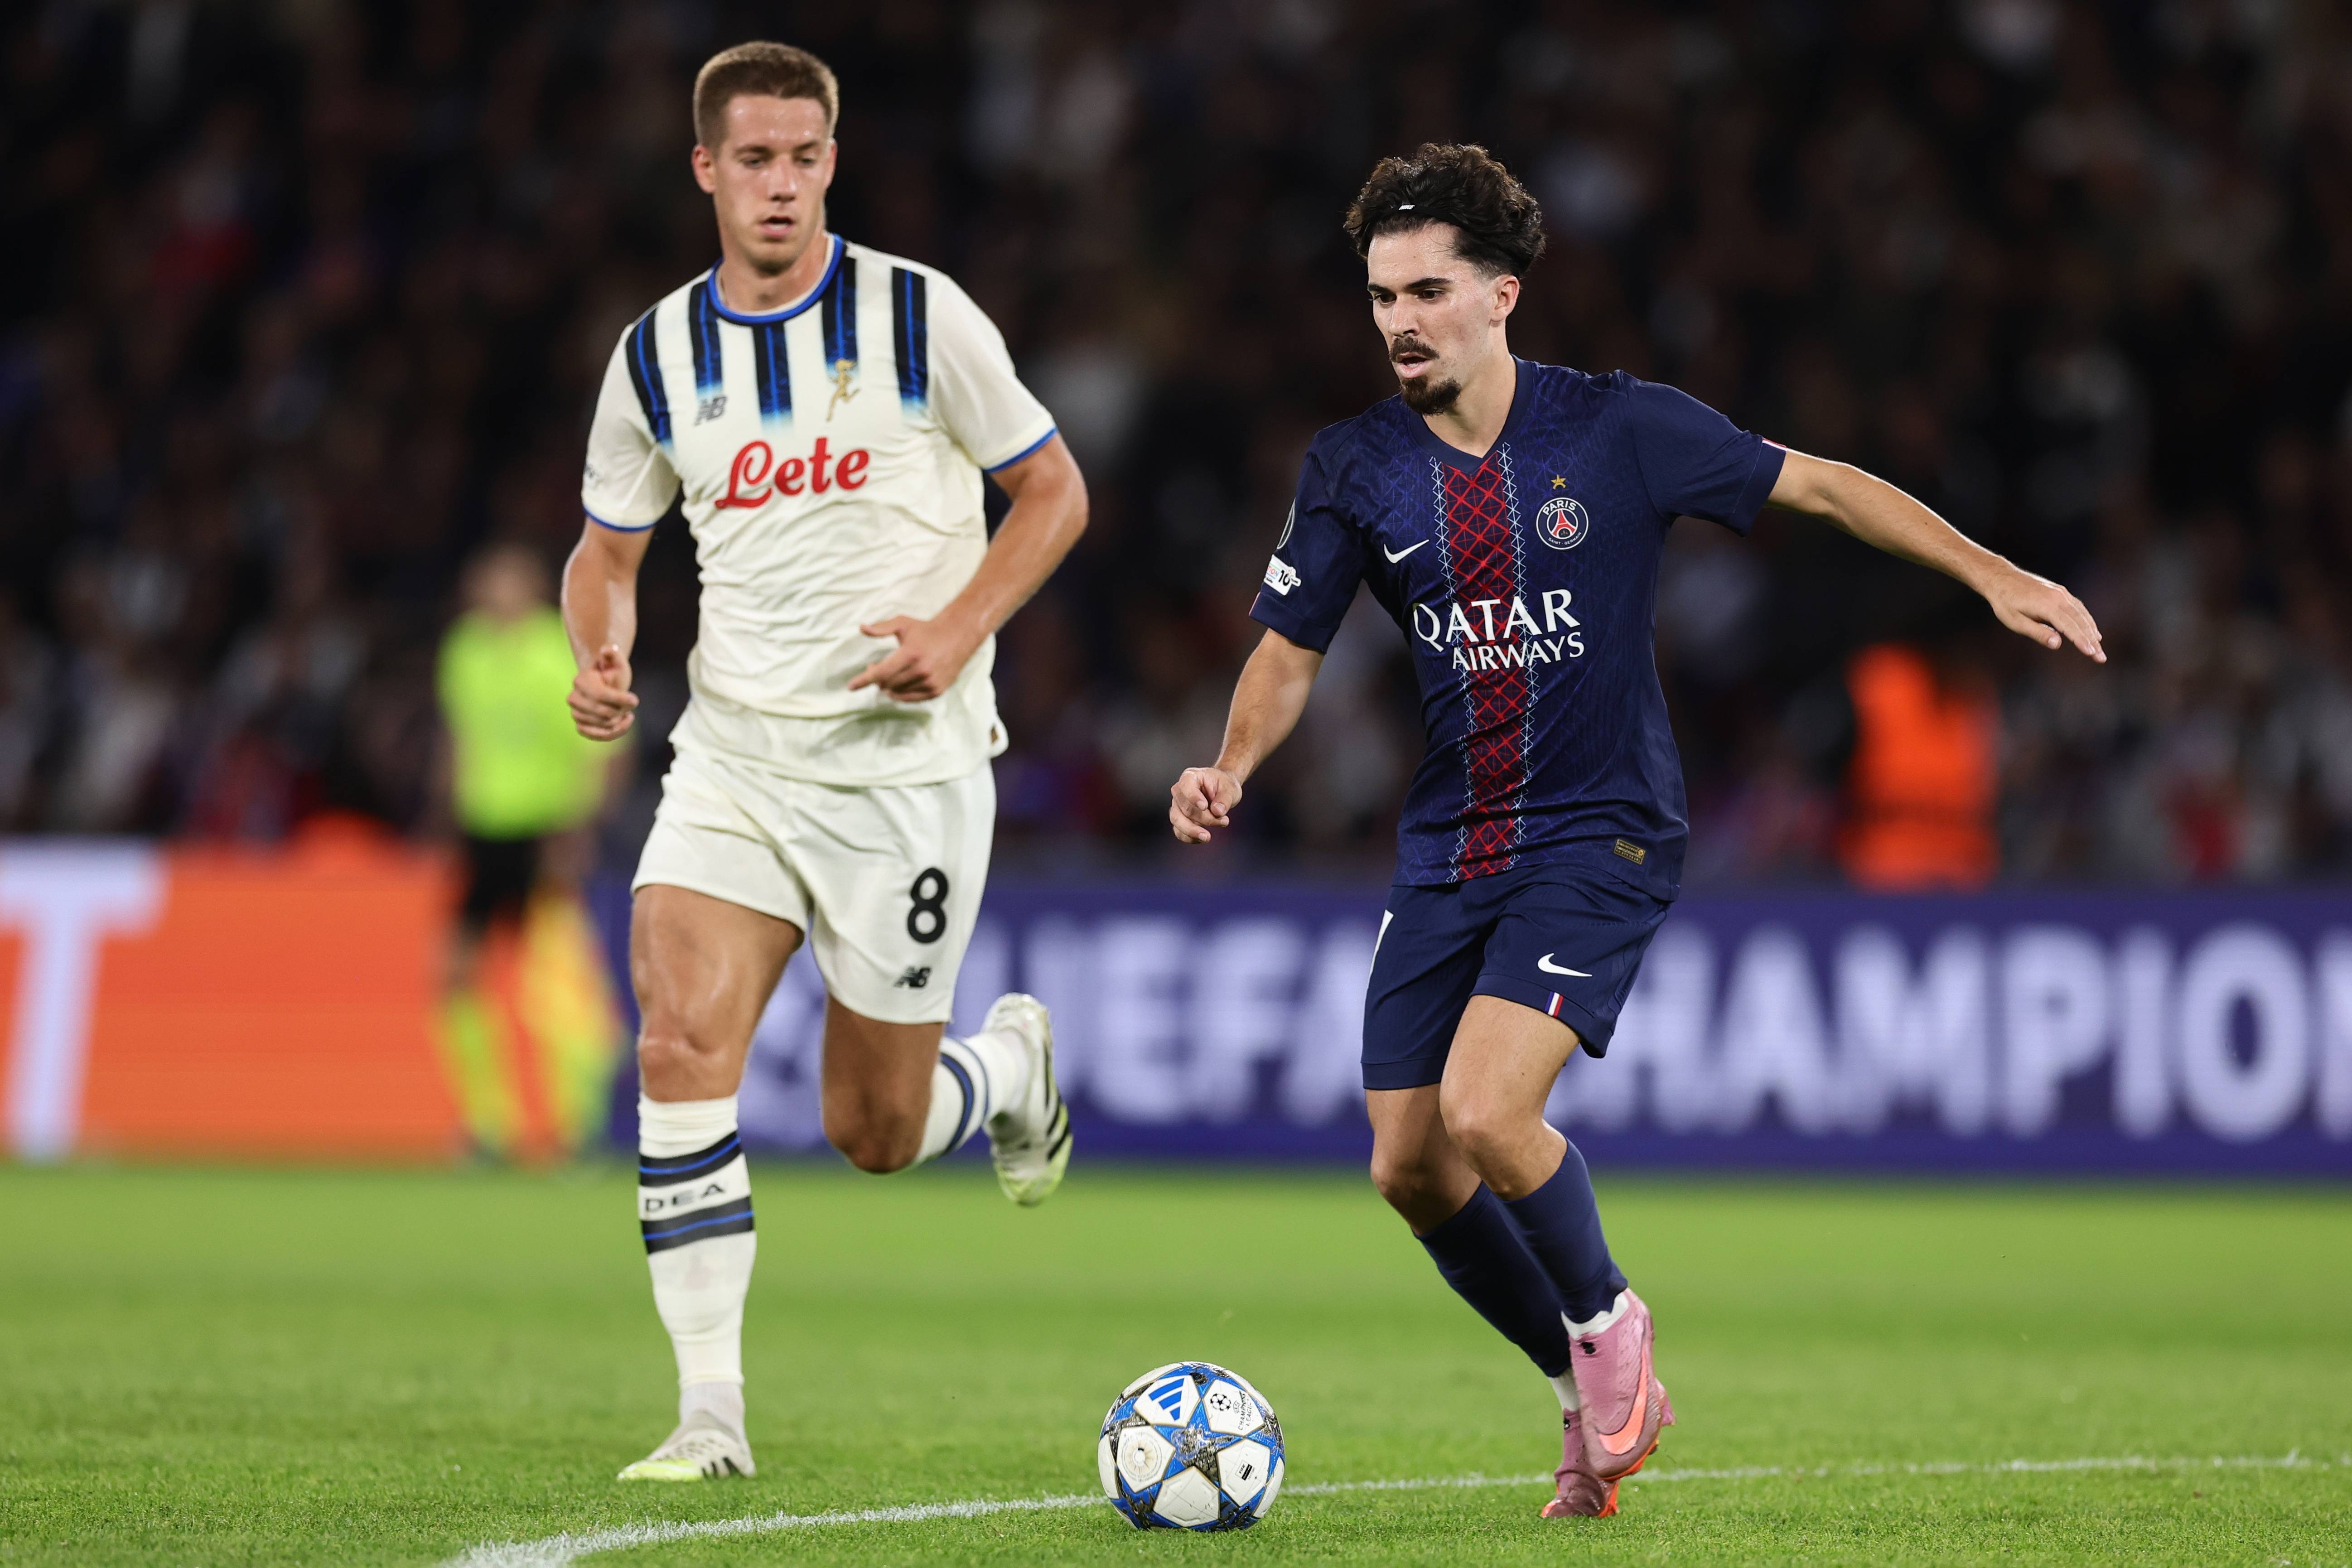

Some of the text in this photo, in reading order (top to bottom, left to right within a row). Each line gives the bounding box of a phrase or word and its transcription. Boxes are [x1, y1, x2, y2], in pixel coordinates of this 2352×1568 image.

[715, 436, 869, 509] Lete
[1542, 500, 1576, 516] PARIS
[1412, 589, 1581, 652] QATAR
[1451, 632, 1584, 671] AIRWAYS
[907, 867, 949, 943] 8
[1543, 922, 2352, 1138] HAMPIO
